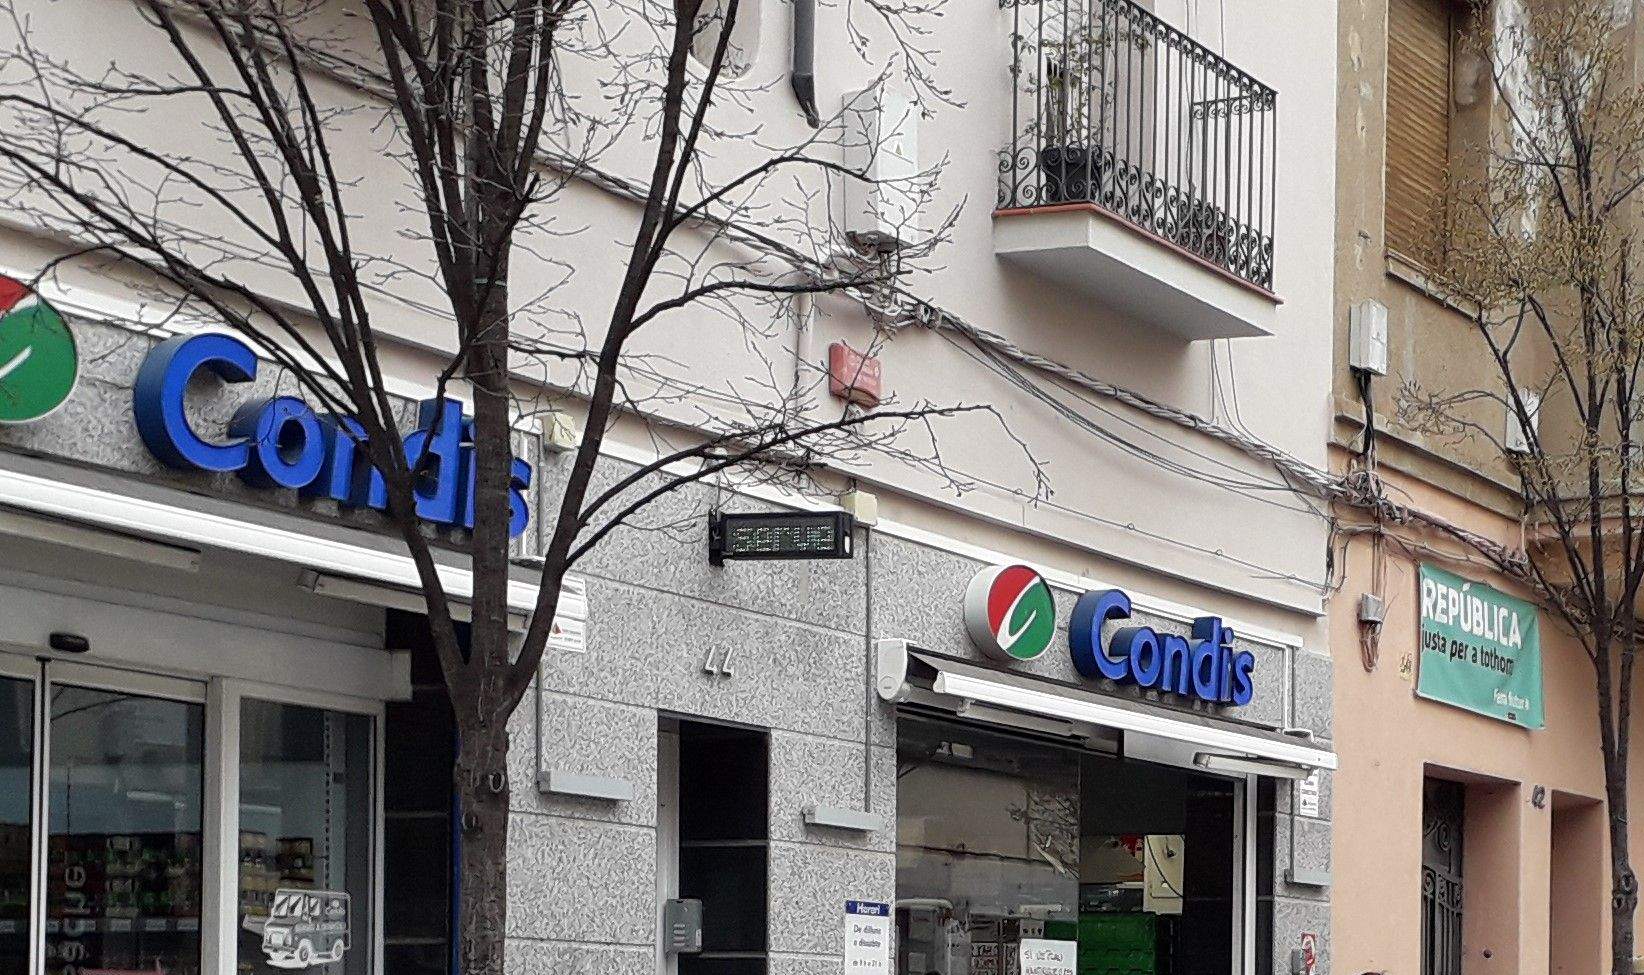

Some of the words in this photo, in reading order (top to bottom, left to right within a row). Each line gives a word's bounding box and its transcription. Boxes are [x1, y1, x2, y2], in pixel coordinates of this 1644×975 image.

[1069, 588, 1255, 706] Condis
[1422, 578, 1522, 649] REPÚBLICA
[1422, 624, 1447, 654] justa
[1450, 639, 1469, 662] per
[1471, 646, 1478, 663] a
[1480, 645, 1514, 676] tothom
